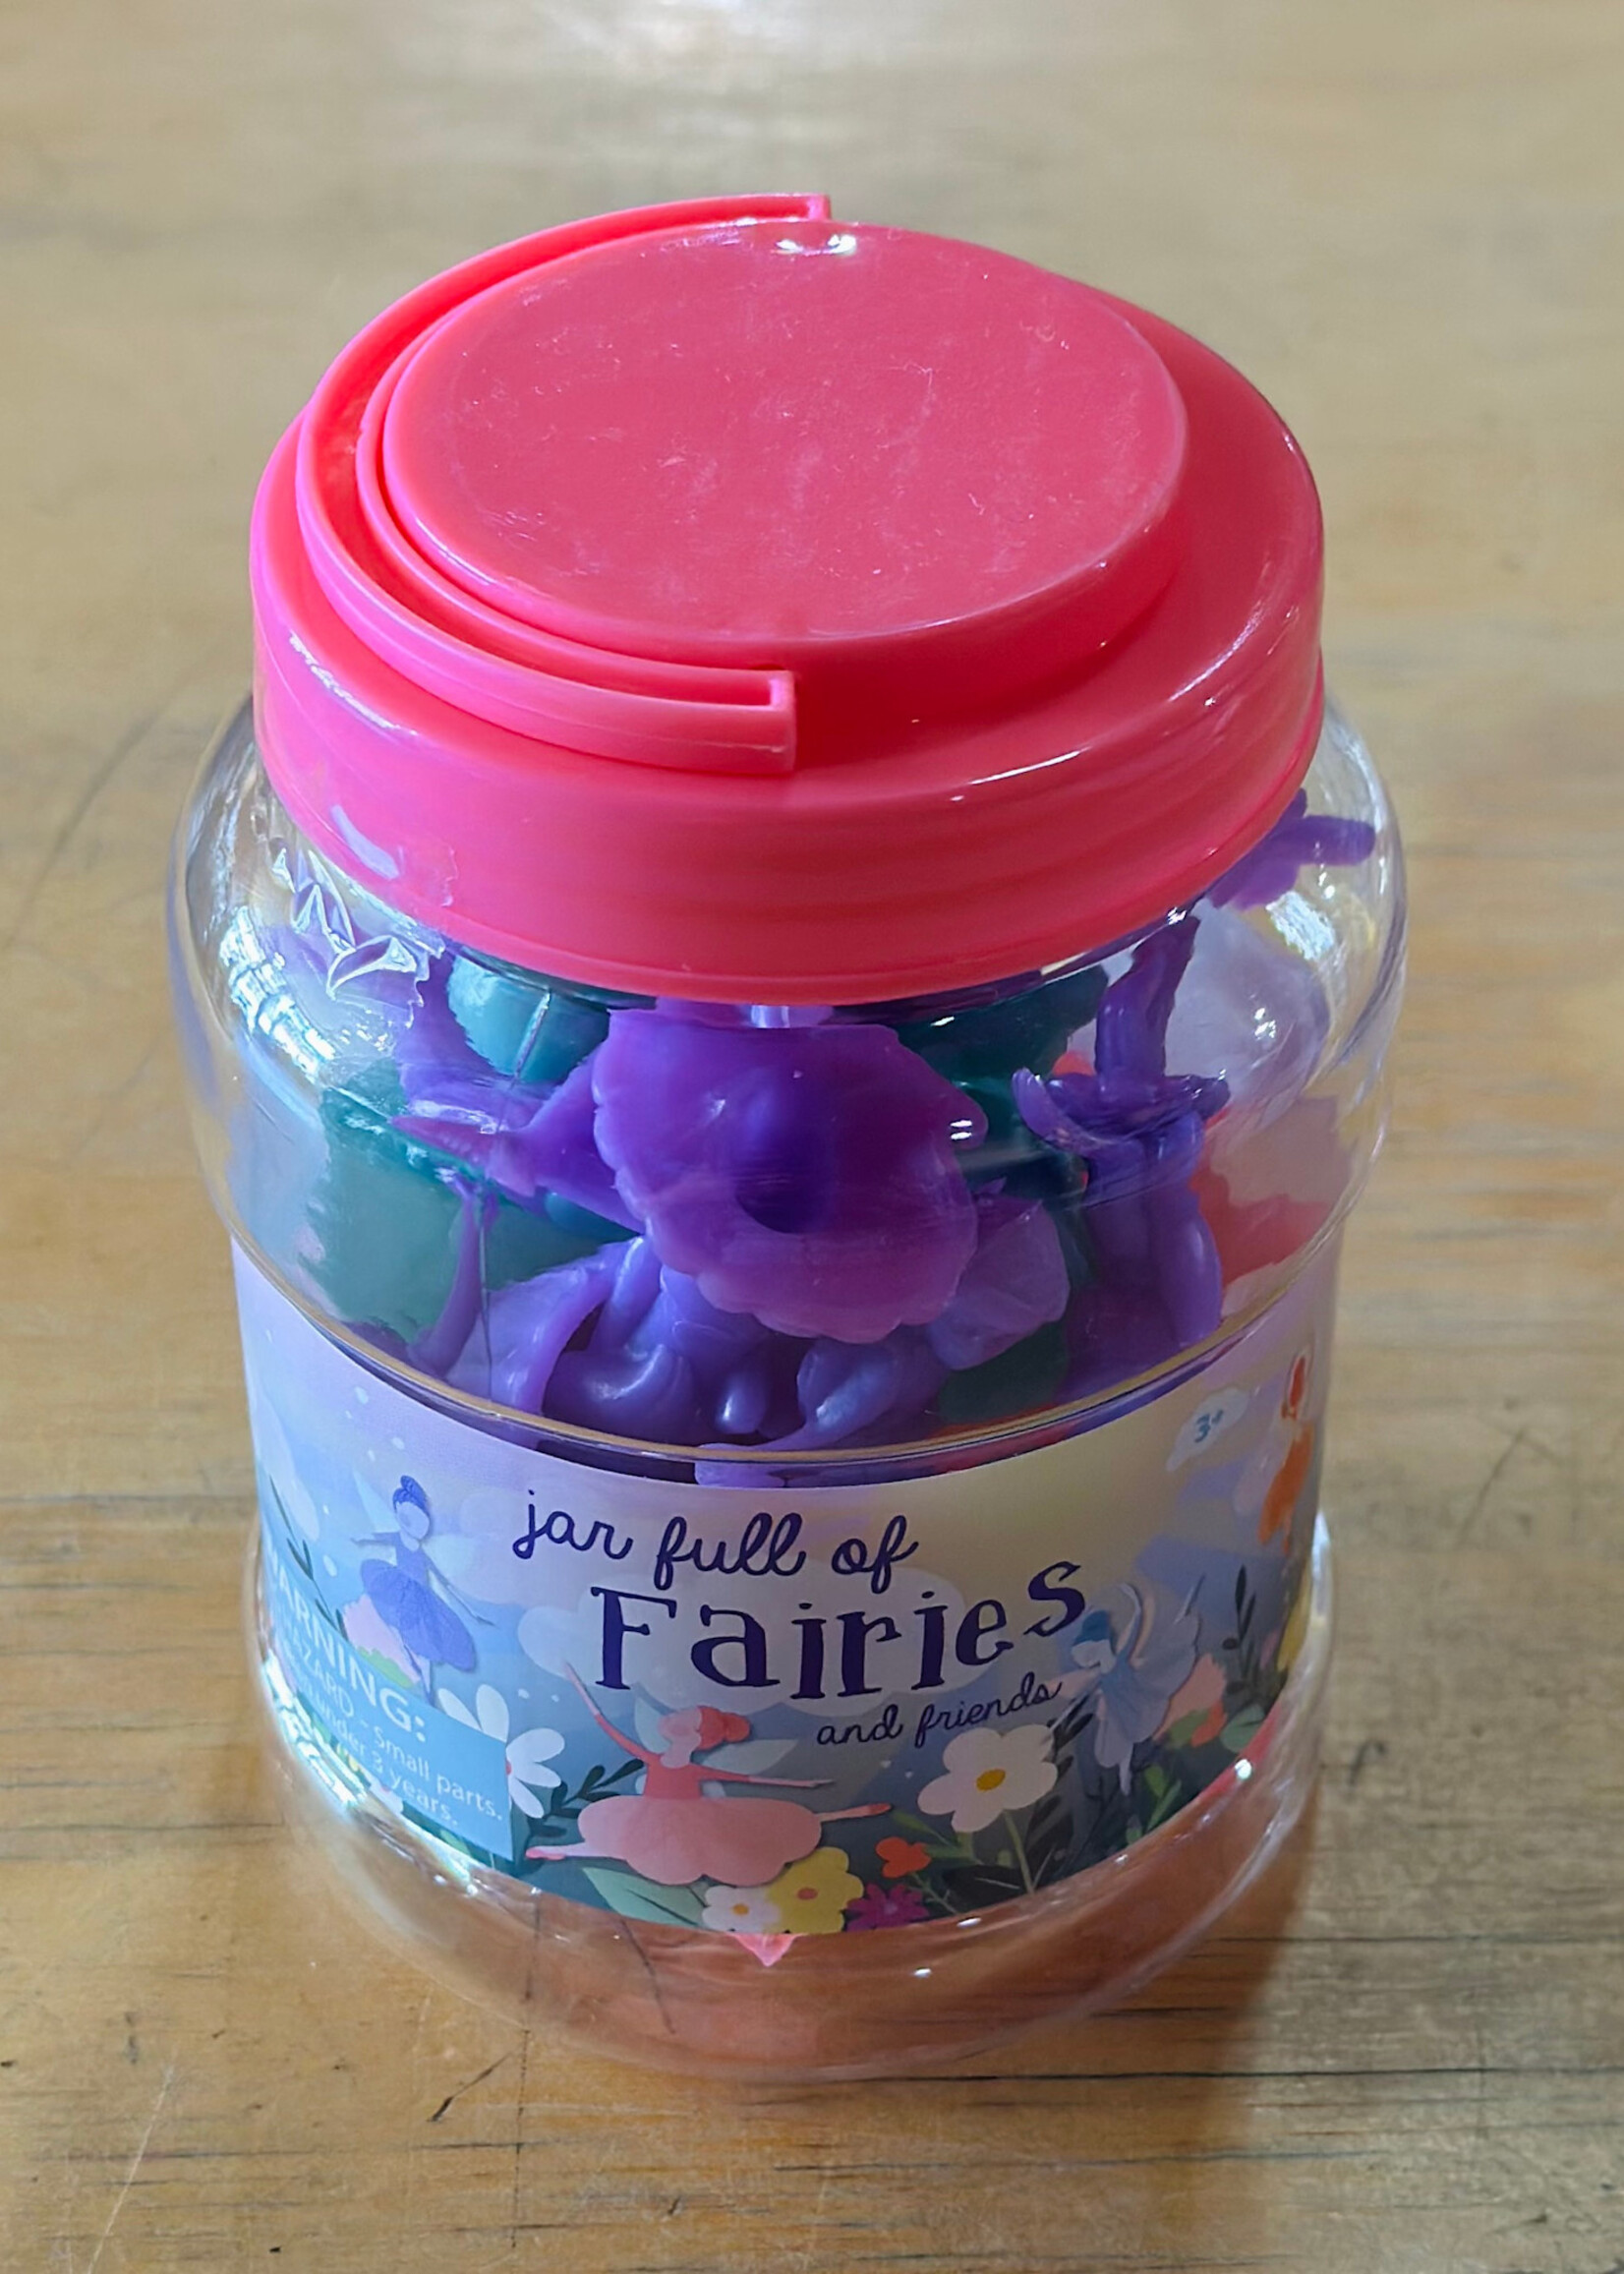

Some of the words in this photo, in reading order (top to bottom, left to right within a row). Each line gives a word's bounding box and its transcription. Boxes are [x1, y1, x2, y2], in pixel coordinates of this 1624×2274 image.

[512, 1489, 634, 1560] jar
[654, 1511, 806, 1591] full
[832, 1515, 919, 1594] of
[590, 1561, 1087, 1701] Fairies
[817, 1705, 904, 1746] and
[914, 1672, 1064, 1749] friends
[374, 1725, 431, 1780] Small
[435, 1775, 503, 1821] parts.
[389, 1768, 458, 1826] years.
